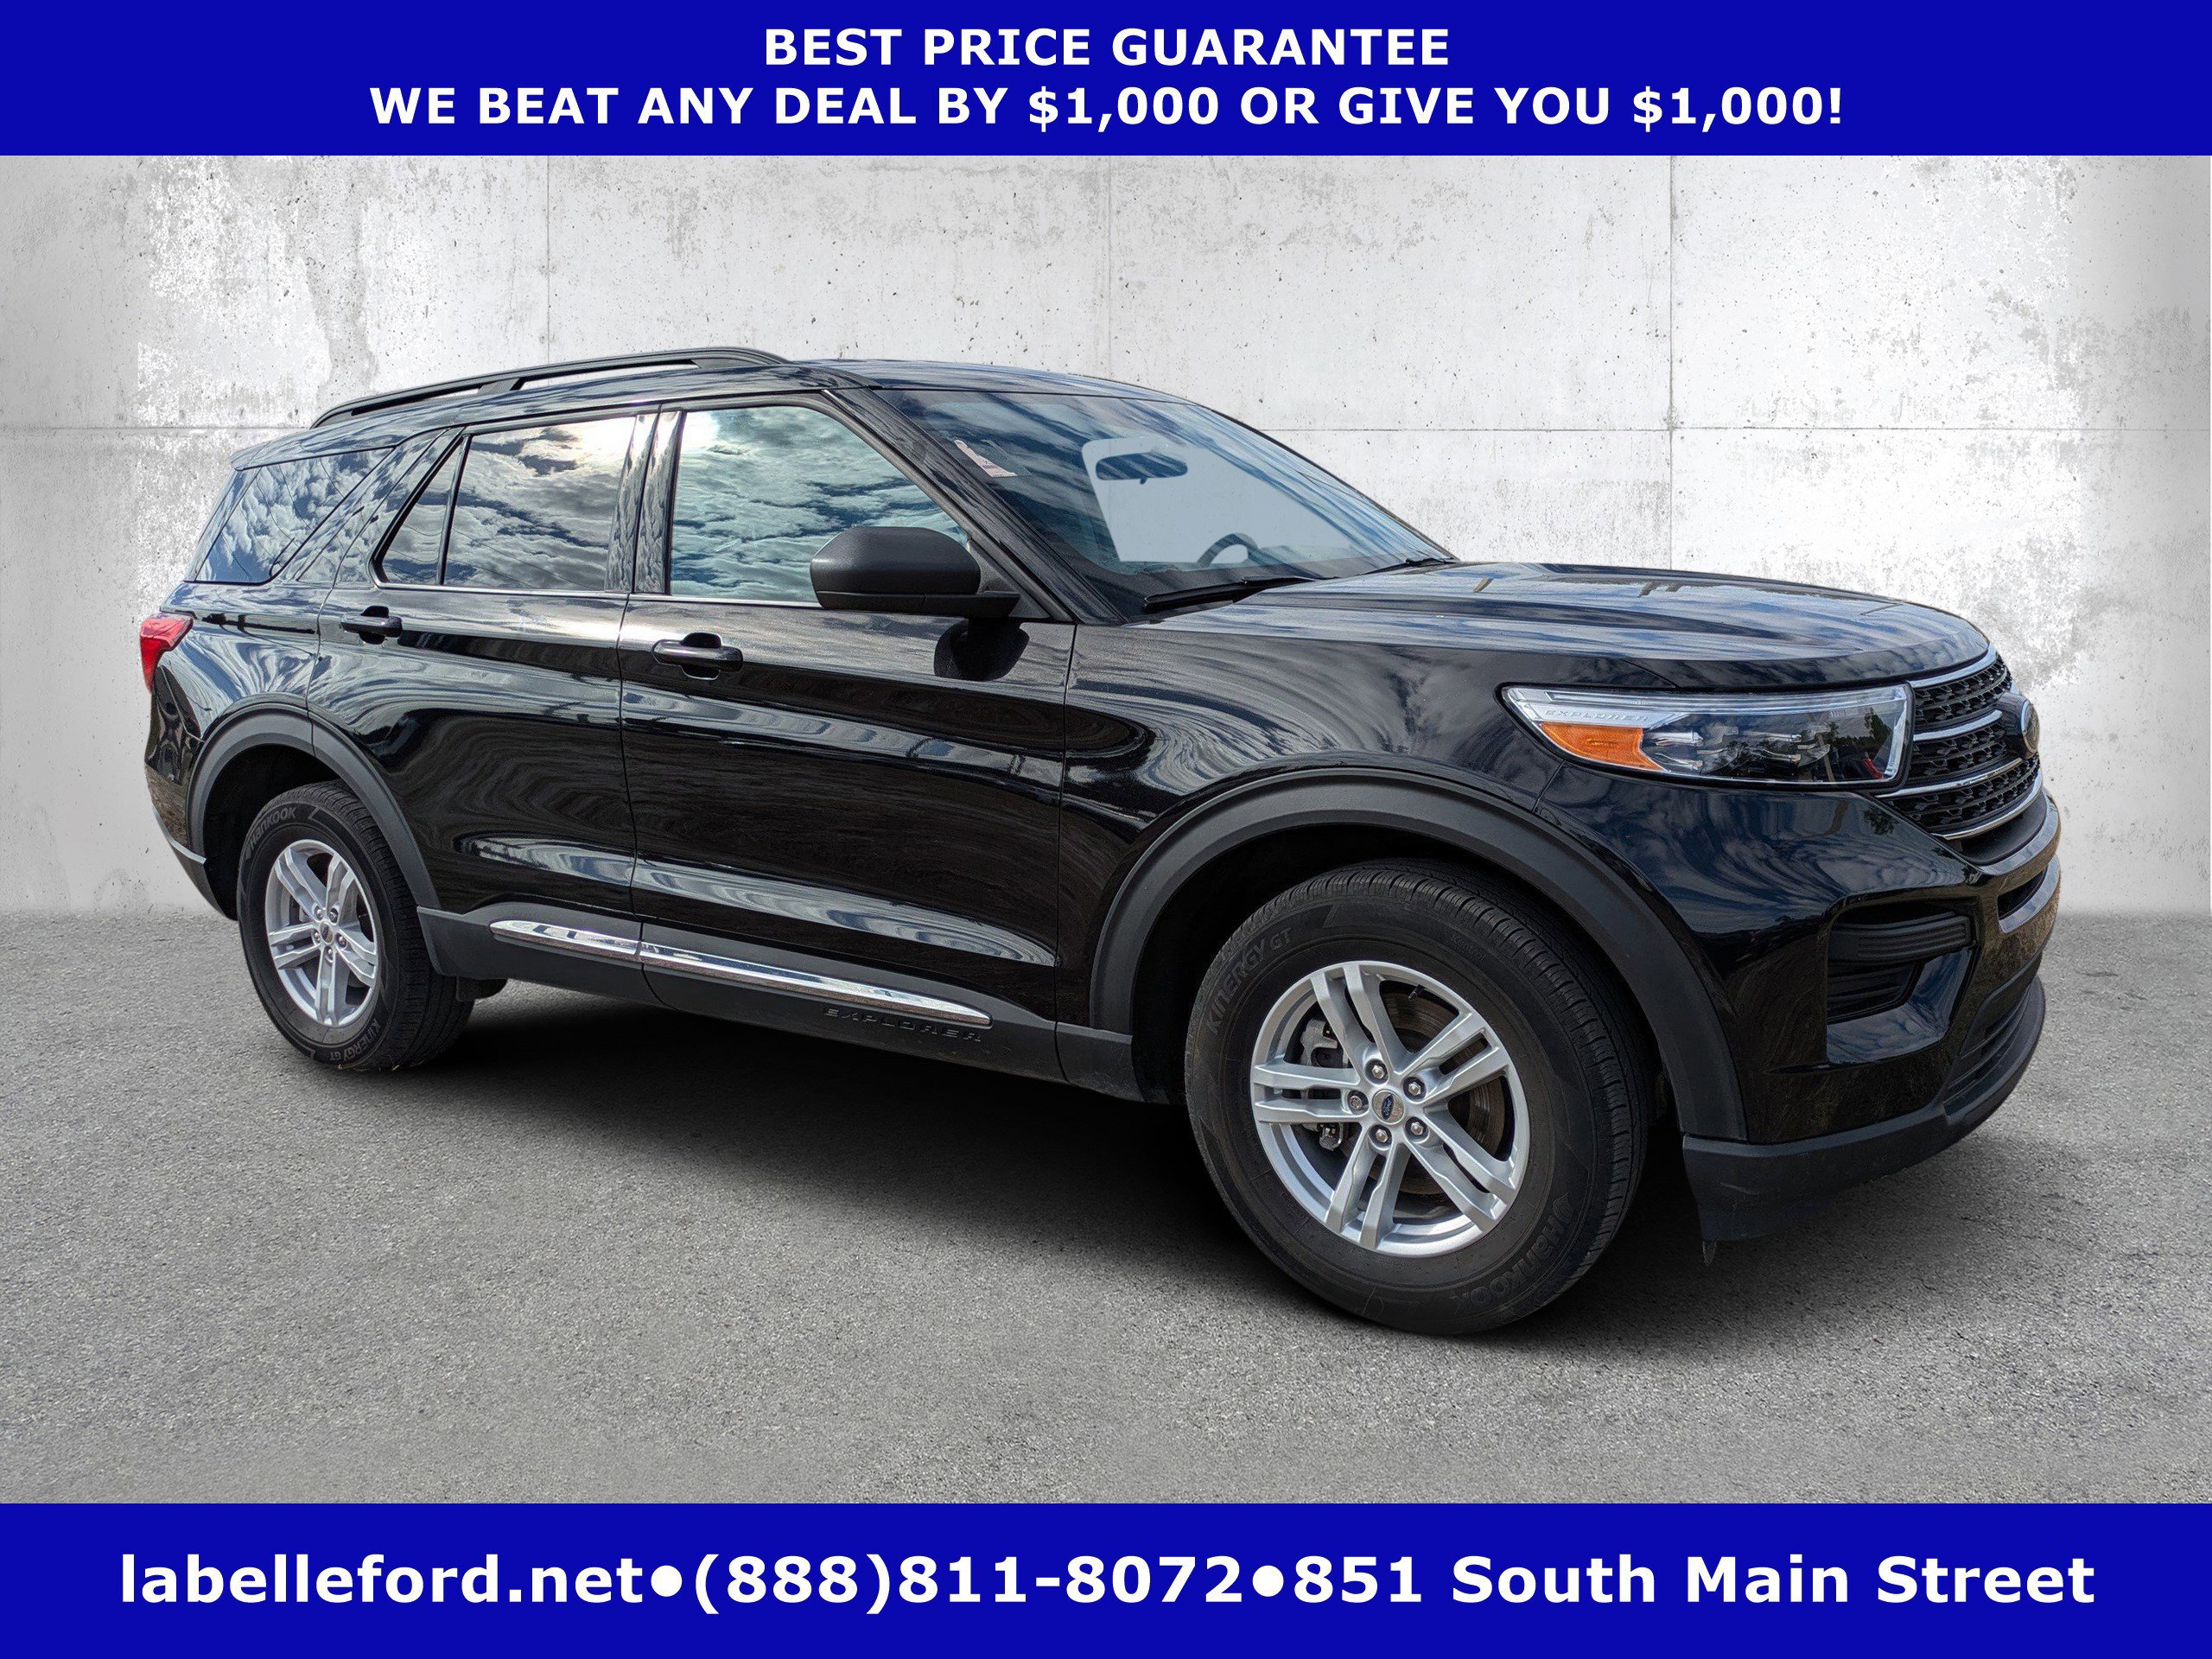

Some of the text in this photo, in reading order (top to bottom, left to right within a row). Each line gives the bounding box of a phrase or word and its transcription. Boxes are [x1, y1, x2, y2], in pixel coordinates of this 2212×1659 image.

[1544, 709, 1649, 722] EXPLORER
[1269, 926, 1293, 951] GT
[824, 1007, 982, 1043] EXPLORER
